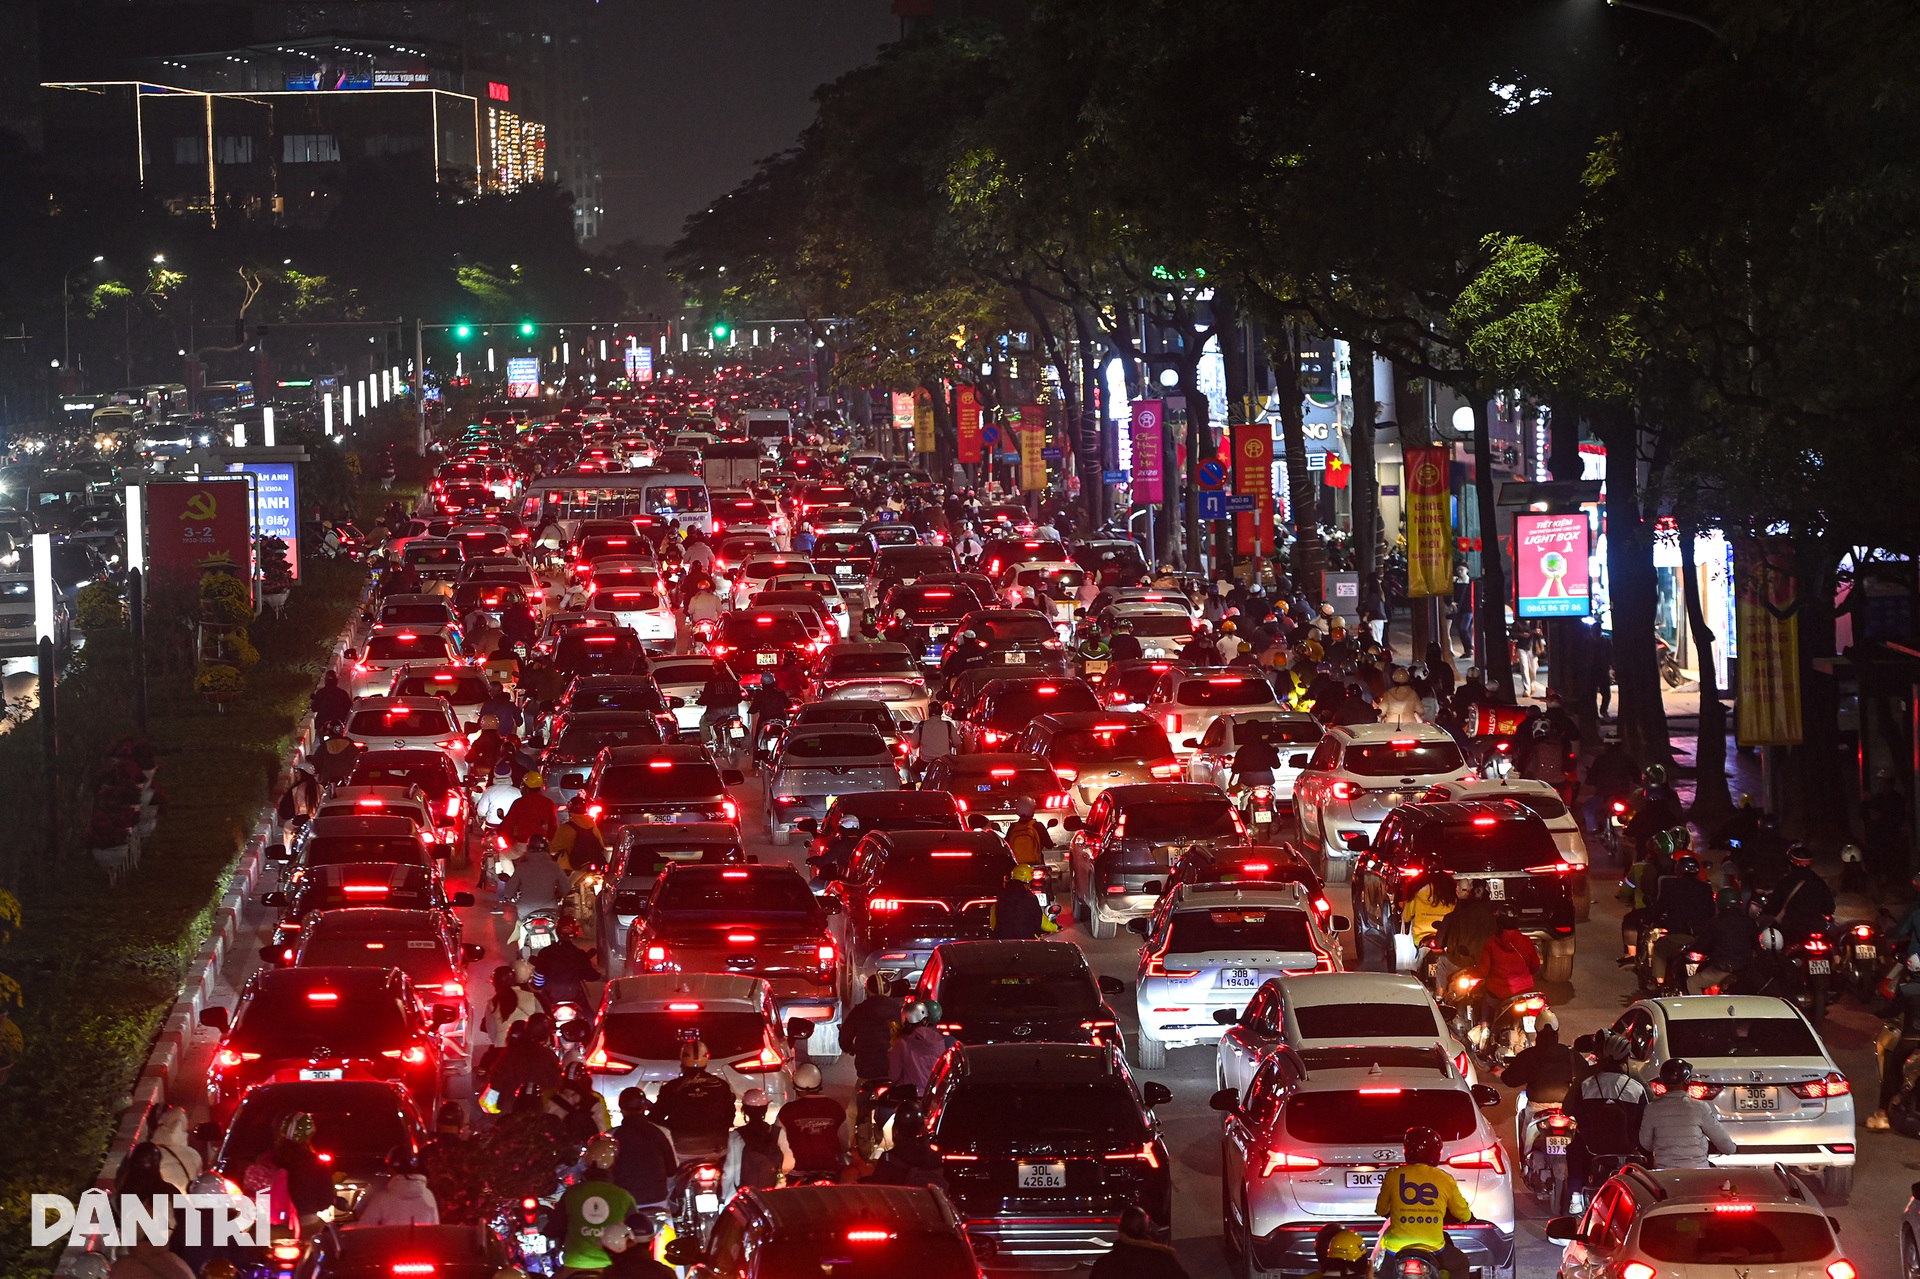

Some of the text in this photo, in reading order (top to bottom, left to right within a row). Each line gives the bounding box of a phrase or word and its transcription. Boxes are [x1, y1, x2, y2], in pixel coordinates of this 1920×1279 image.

[266, 514, 289, 527] Giấy
[1536, 518, 1573, 529] TIẾT KIỆM
[184, 527, 213, 537] 3-2
[1524, 531, 1581, 545] LIGHT BOX
[1226, 978, 1255, 987] 194.04
[1747, 1089, 1766, 1099] 30G
[1031, 1165, 1052, 1176] 30L
[1023, 1176, 1060, 1187] 426.84
[1400, 1173, 1439, 1206] be
